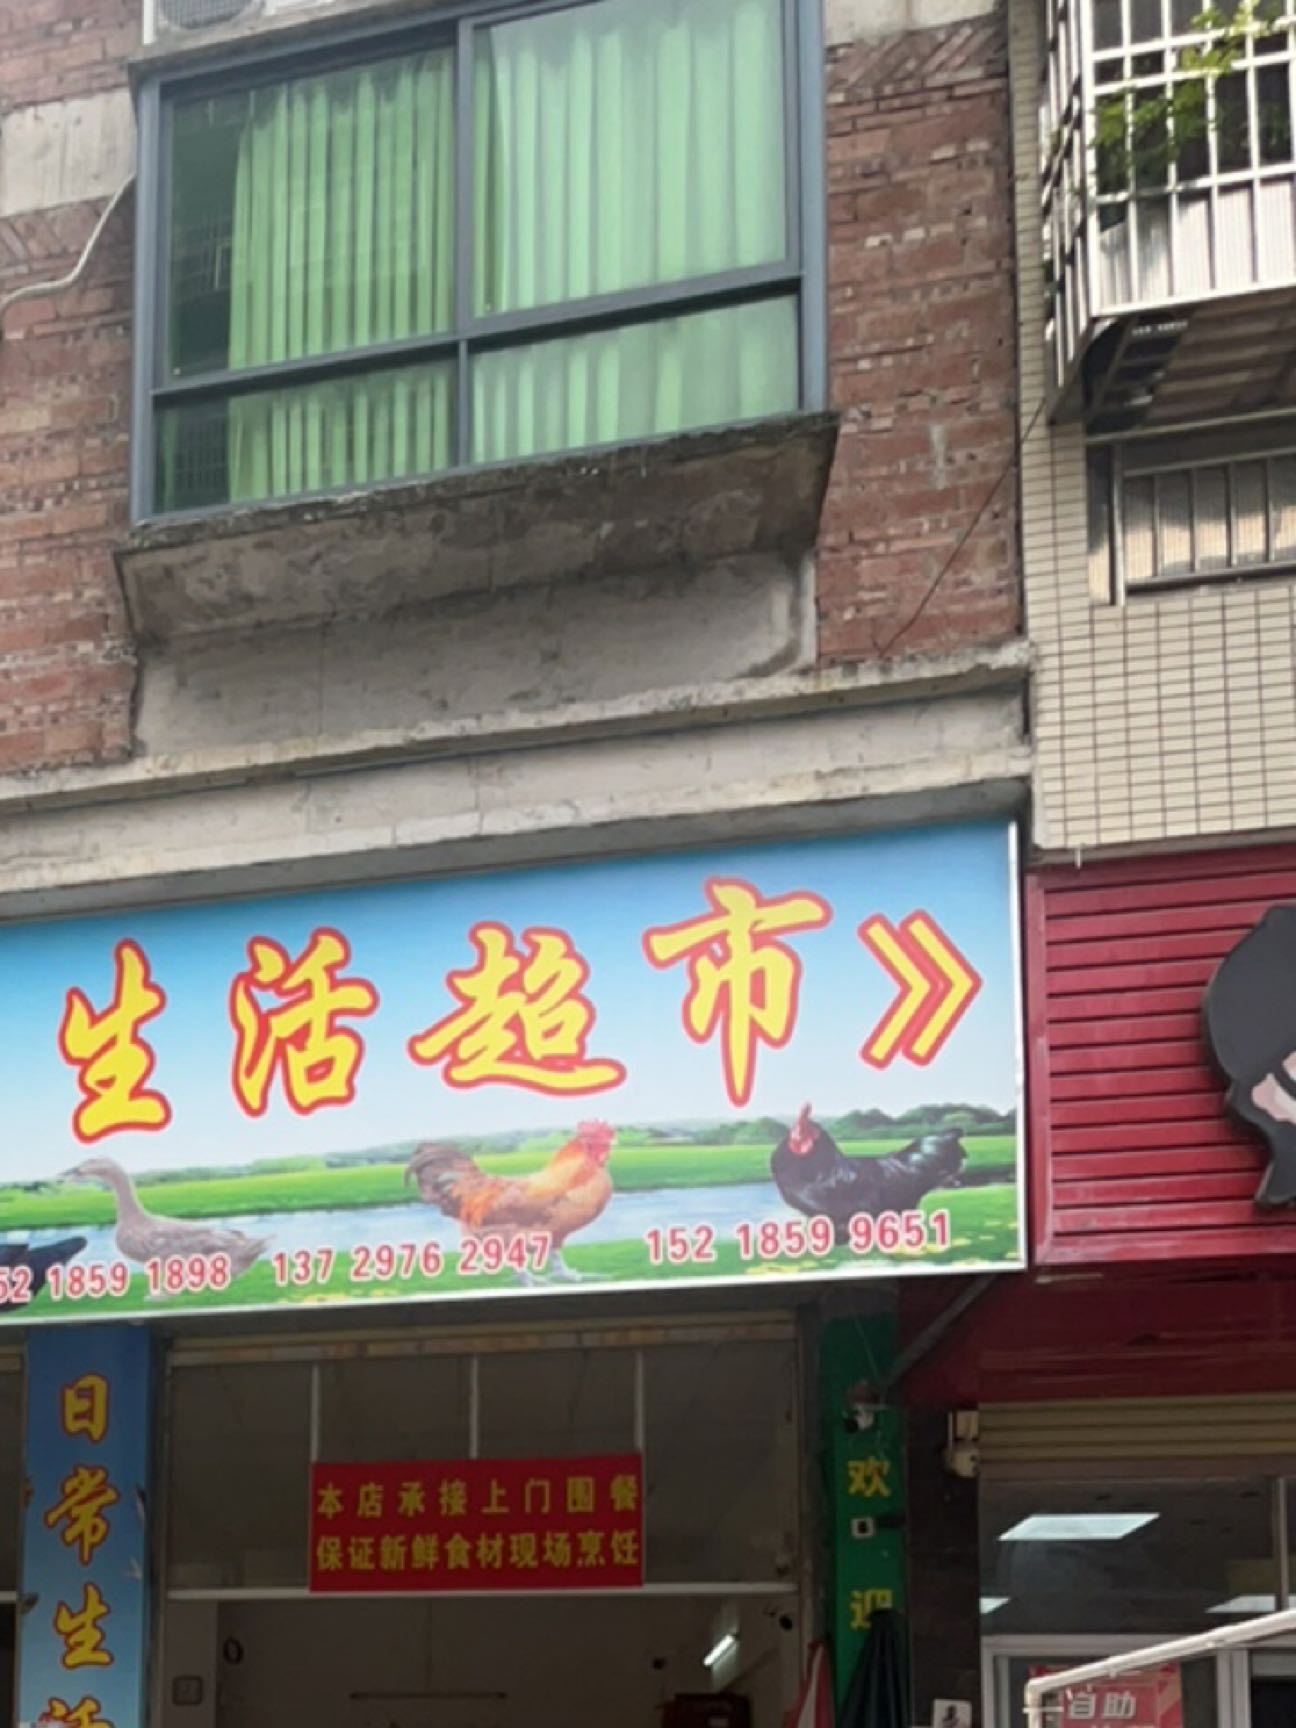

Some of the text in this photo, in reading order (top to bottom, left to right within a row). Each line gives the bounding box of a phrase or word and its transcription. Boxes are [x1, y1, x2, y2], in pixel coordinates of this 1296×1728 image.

[47, 1261, 128, 1299] 1859
[145, 1254, 230, 1293] 1898
[272, 1248, 335, 1286] 137
[351, 1241, 442, 1280] 2976
[458, 1232, 551, 1275] 2947
[645, 1224, 715, 1264] 152
[736, 1216, 834, 1259] 1859
[850, 1209, 949, 1253] 9651
[317, 1475, 638, 1518] 本店承接上门围餐
[316, 1529, 639, 1571] 保证新鲜食材现场烹饪
